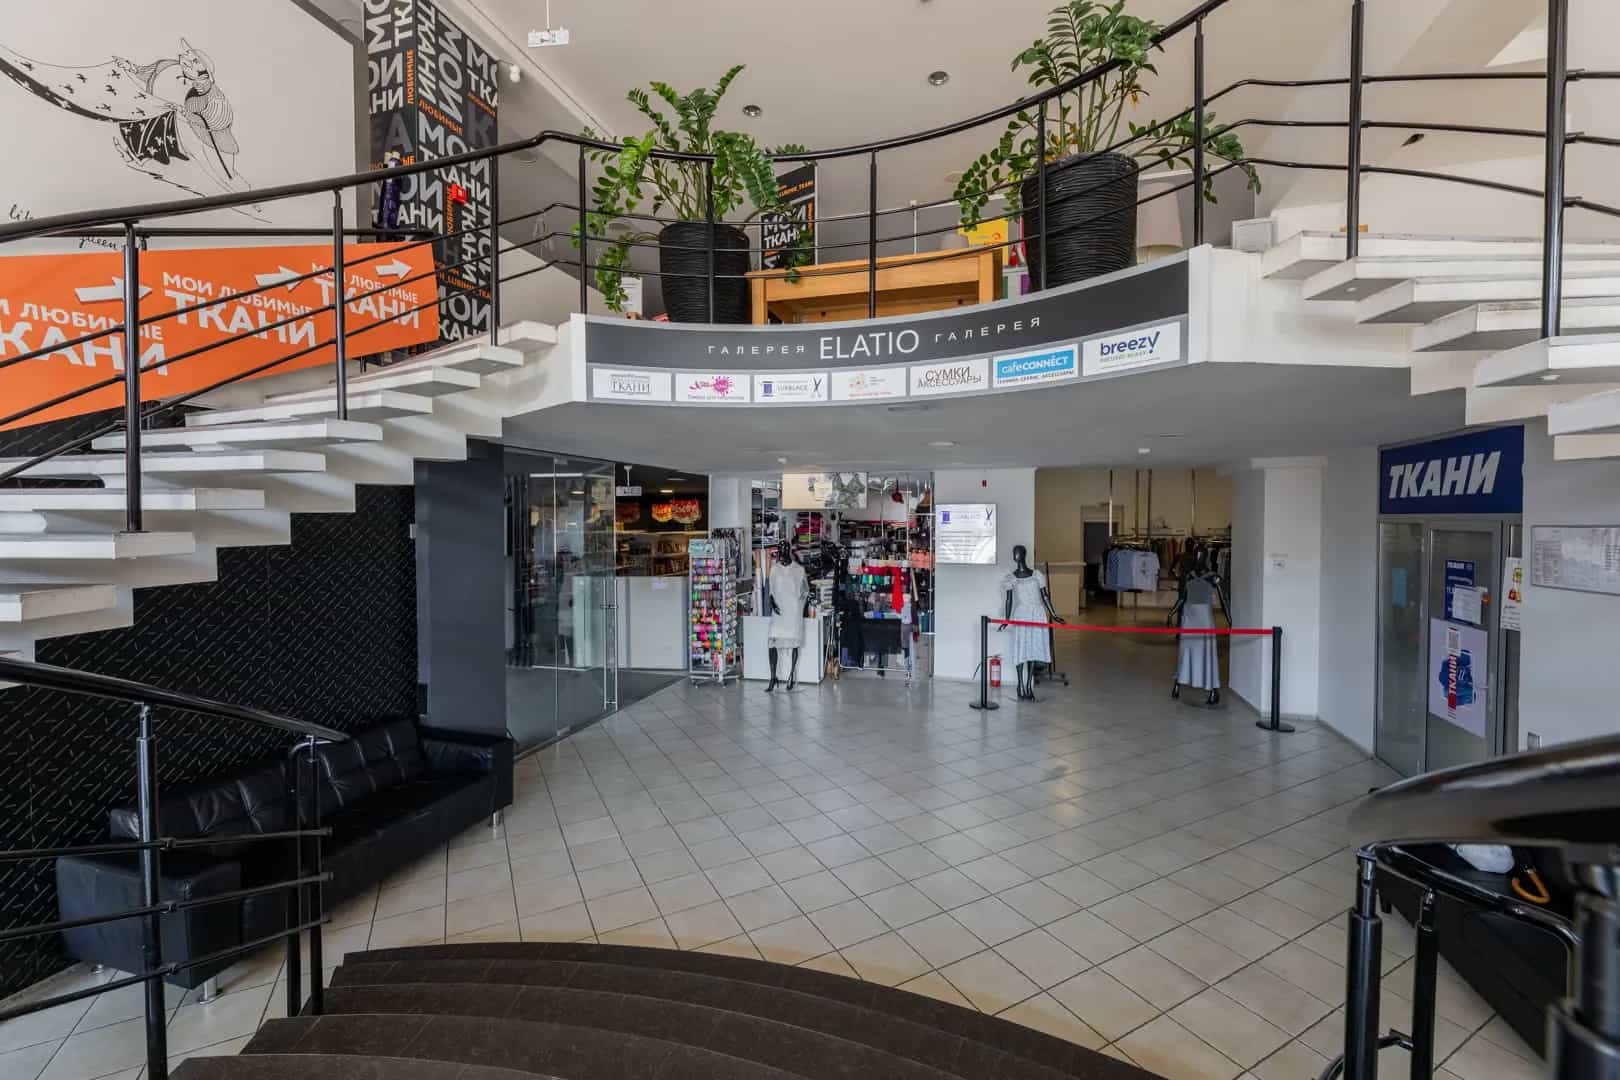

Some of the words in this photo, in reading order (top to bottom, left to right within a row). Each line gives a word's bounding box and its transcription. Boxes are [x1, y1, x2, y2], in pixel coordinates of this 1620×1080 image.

[418, 98, 463, 137] ЛЮБИМЫЕ
[162, 271, 213, 296] МОИ
[220, 286, 313, 319] ЛЮБИМЫЕ
[312, 276, 420, 329] ТКАНИ
[351, 275, 418, 304] ЛЮБИМЫЕ
[164, 289, 317, 347] ТКАНИ
[934, 316, 1041, 344] ГАЛЕРЕЯ
[707, 344, 806, 356] ГАЛЕРЕЯ
[819, 328, 920, 361] ELATIO
[1100, 331, 1161, 356] breezy
[925, 366, 971, 381] СУМКИ
[1388, 450, 1501, 499] ТКАНИ
